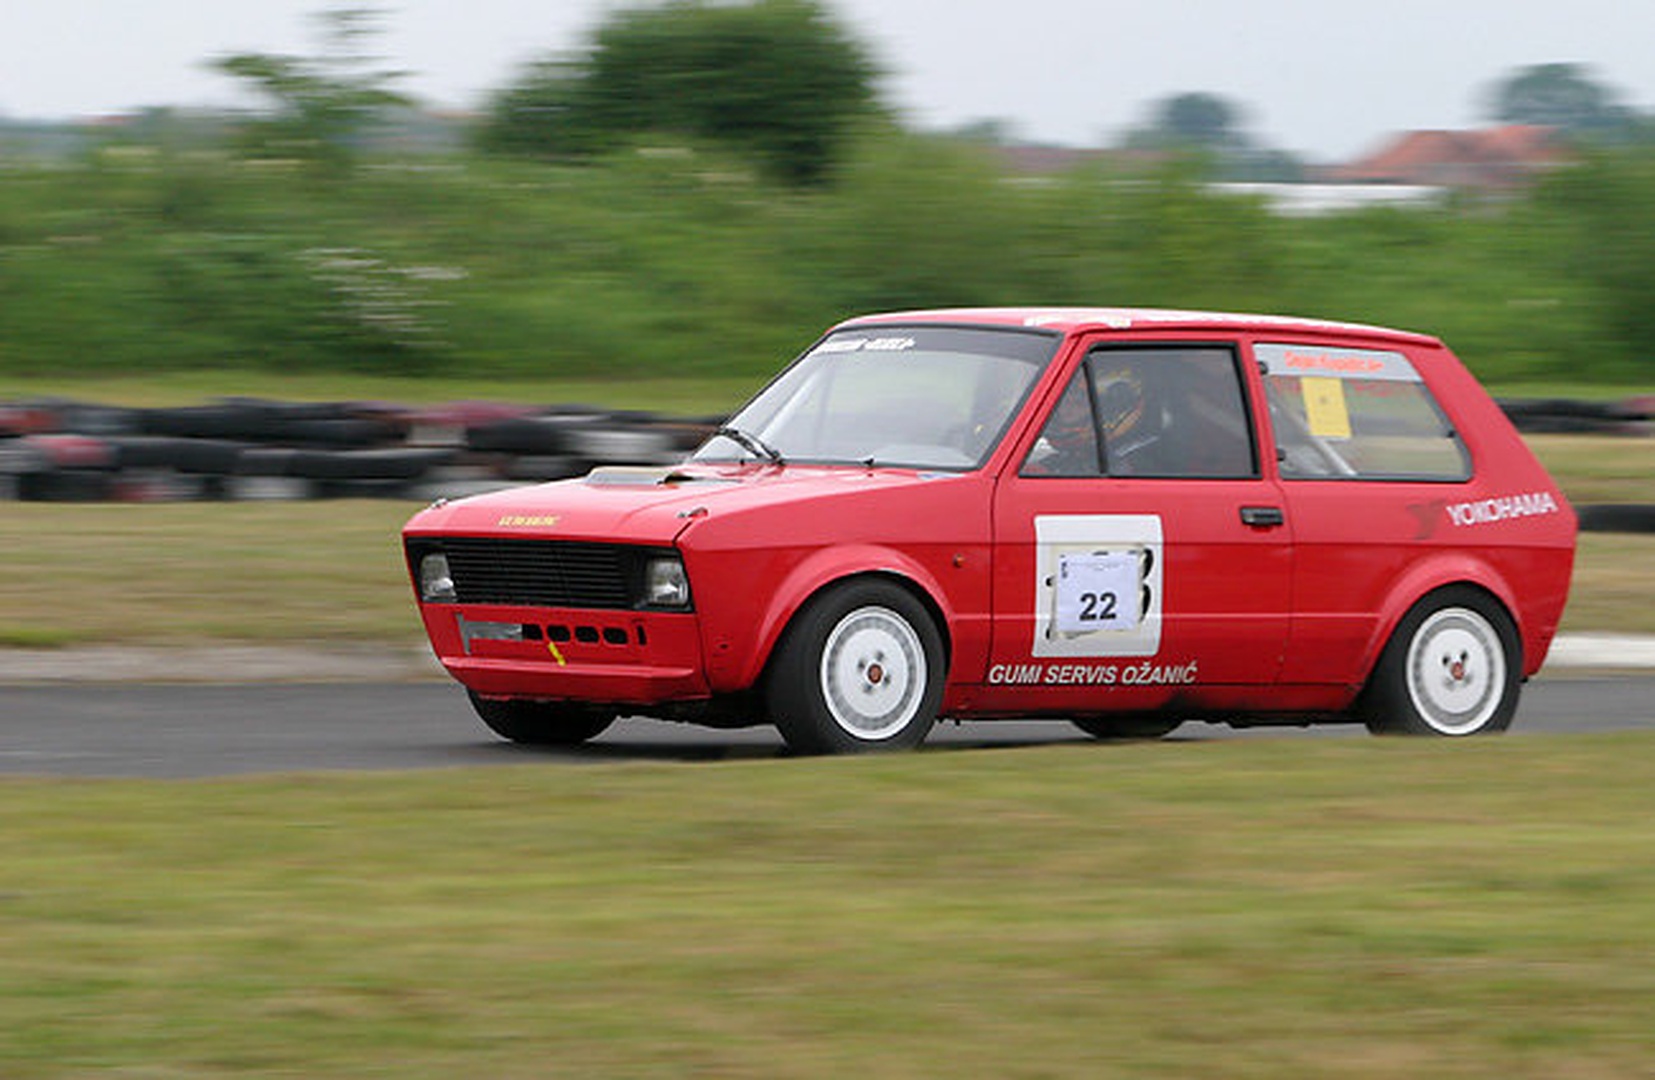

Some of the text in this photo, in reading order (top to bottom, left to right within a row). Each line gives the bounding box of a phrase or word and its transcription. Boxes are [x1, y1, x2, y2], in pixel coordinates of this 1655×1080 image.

[1446, 492, 1558, 525] YOKOHAMA
[1079, 592, 1117, 621] 22
[989, 660, 1198, 684] GUMI SERVIS OŽANIĆ
